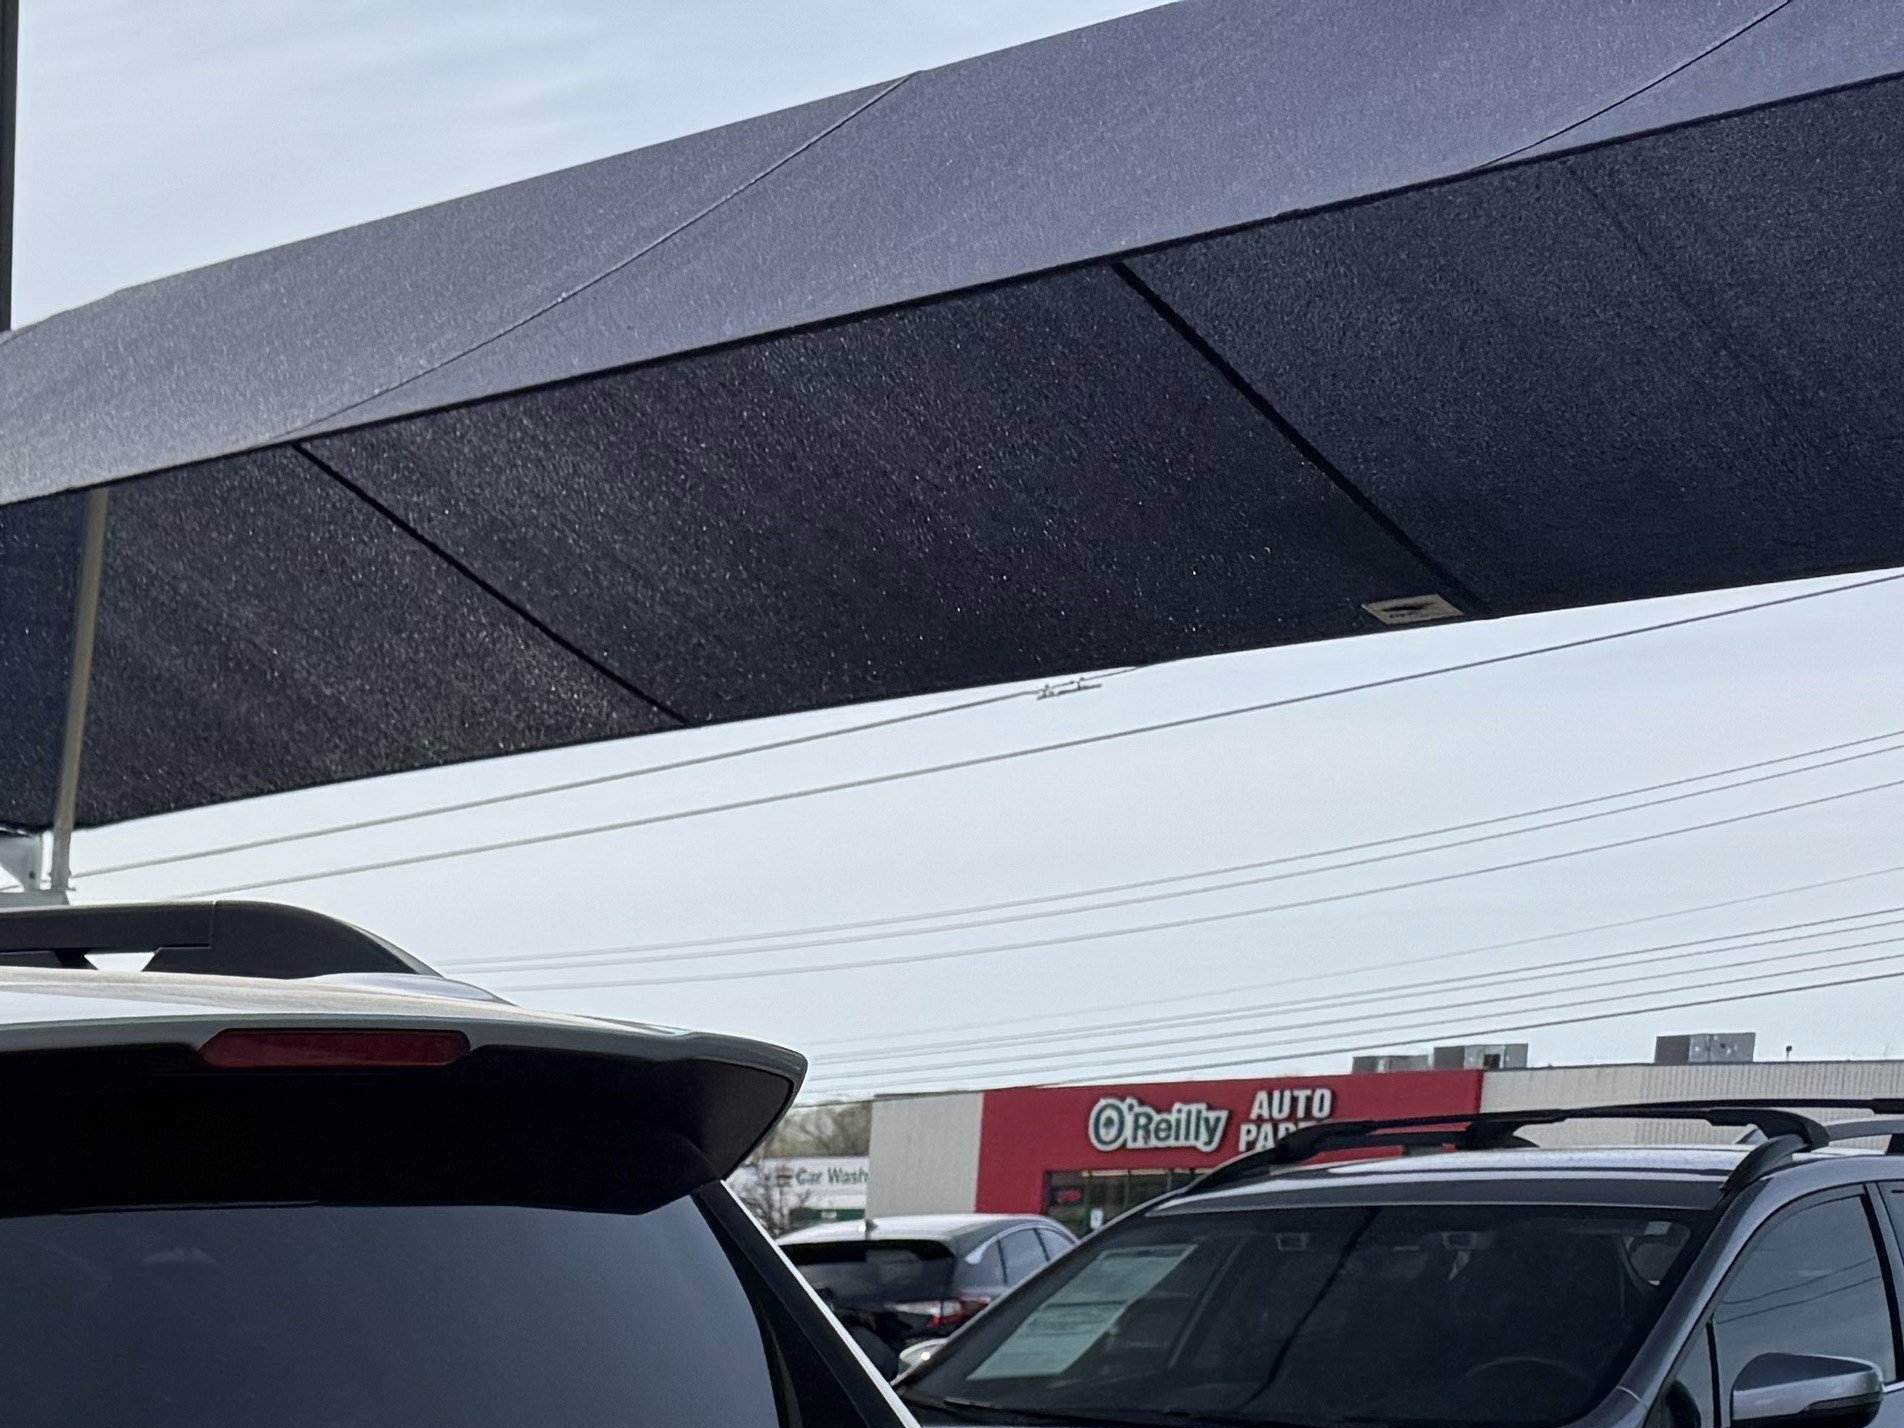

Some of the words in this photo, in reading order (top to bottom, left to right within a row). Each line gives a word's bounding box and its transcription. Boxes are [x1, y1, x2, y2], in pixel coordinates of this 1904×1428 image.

[1249, 1087, 1332, 1120] AUTO
[1089, 1098, 1228, 1152] O'Reilly
[1238, 1121, 1317, 1152] PAR
[796, 1167, 822, 1185] Car
[827, 1166, 869, 1185] Wash
